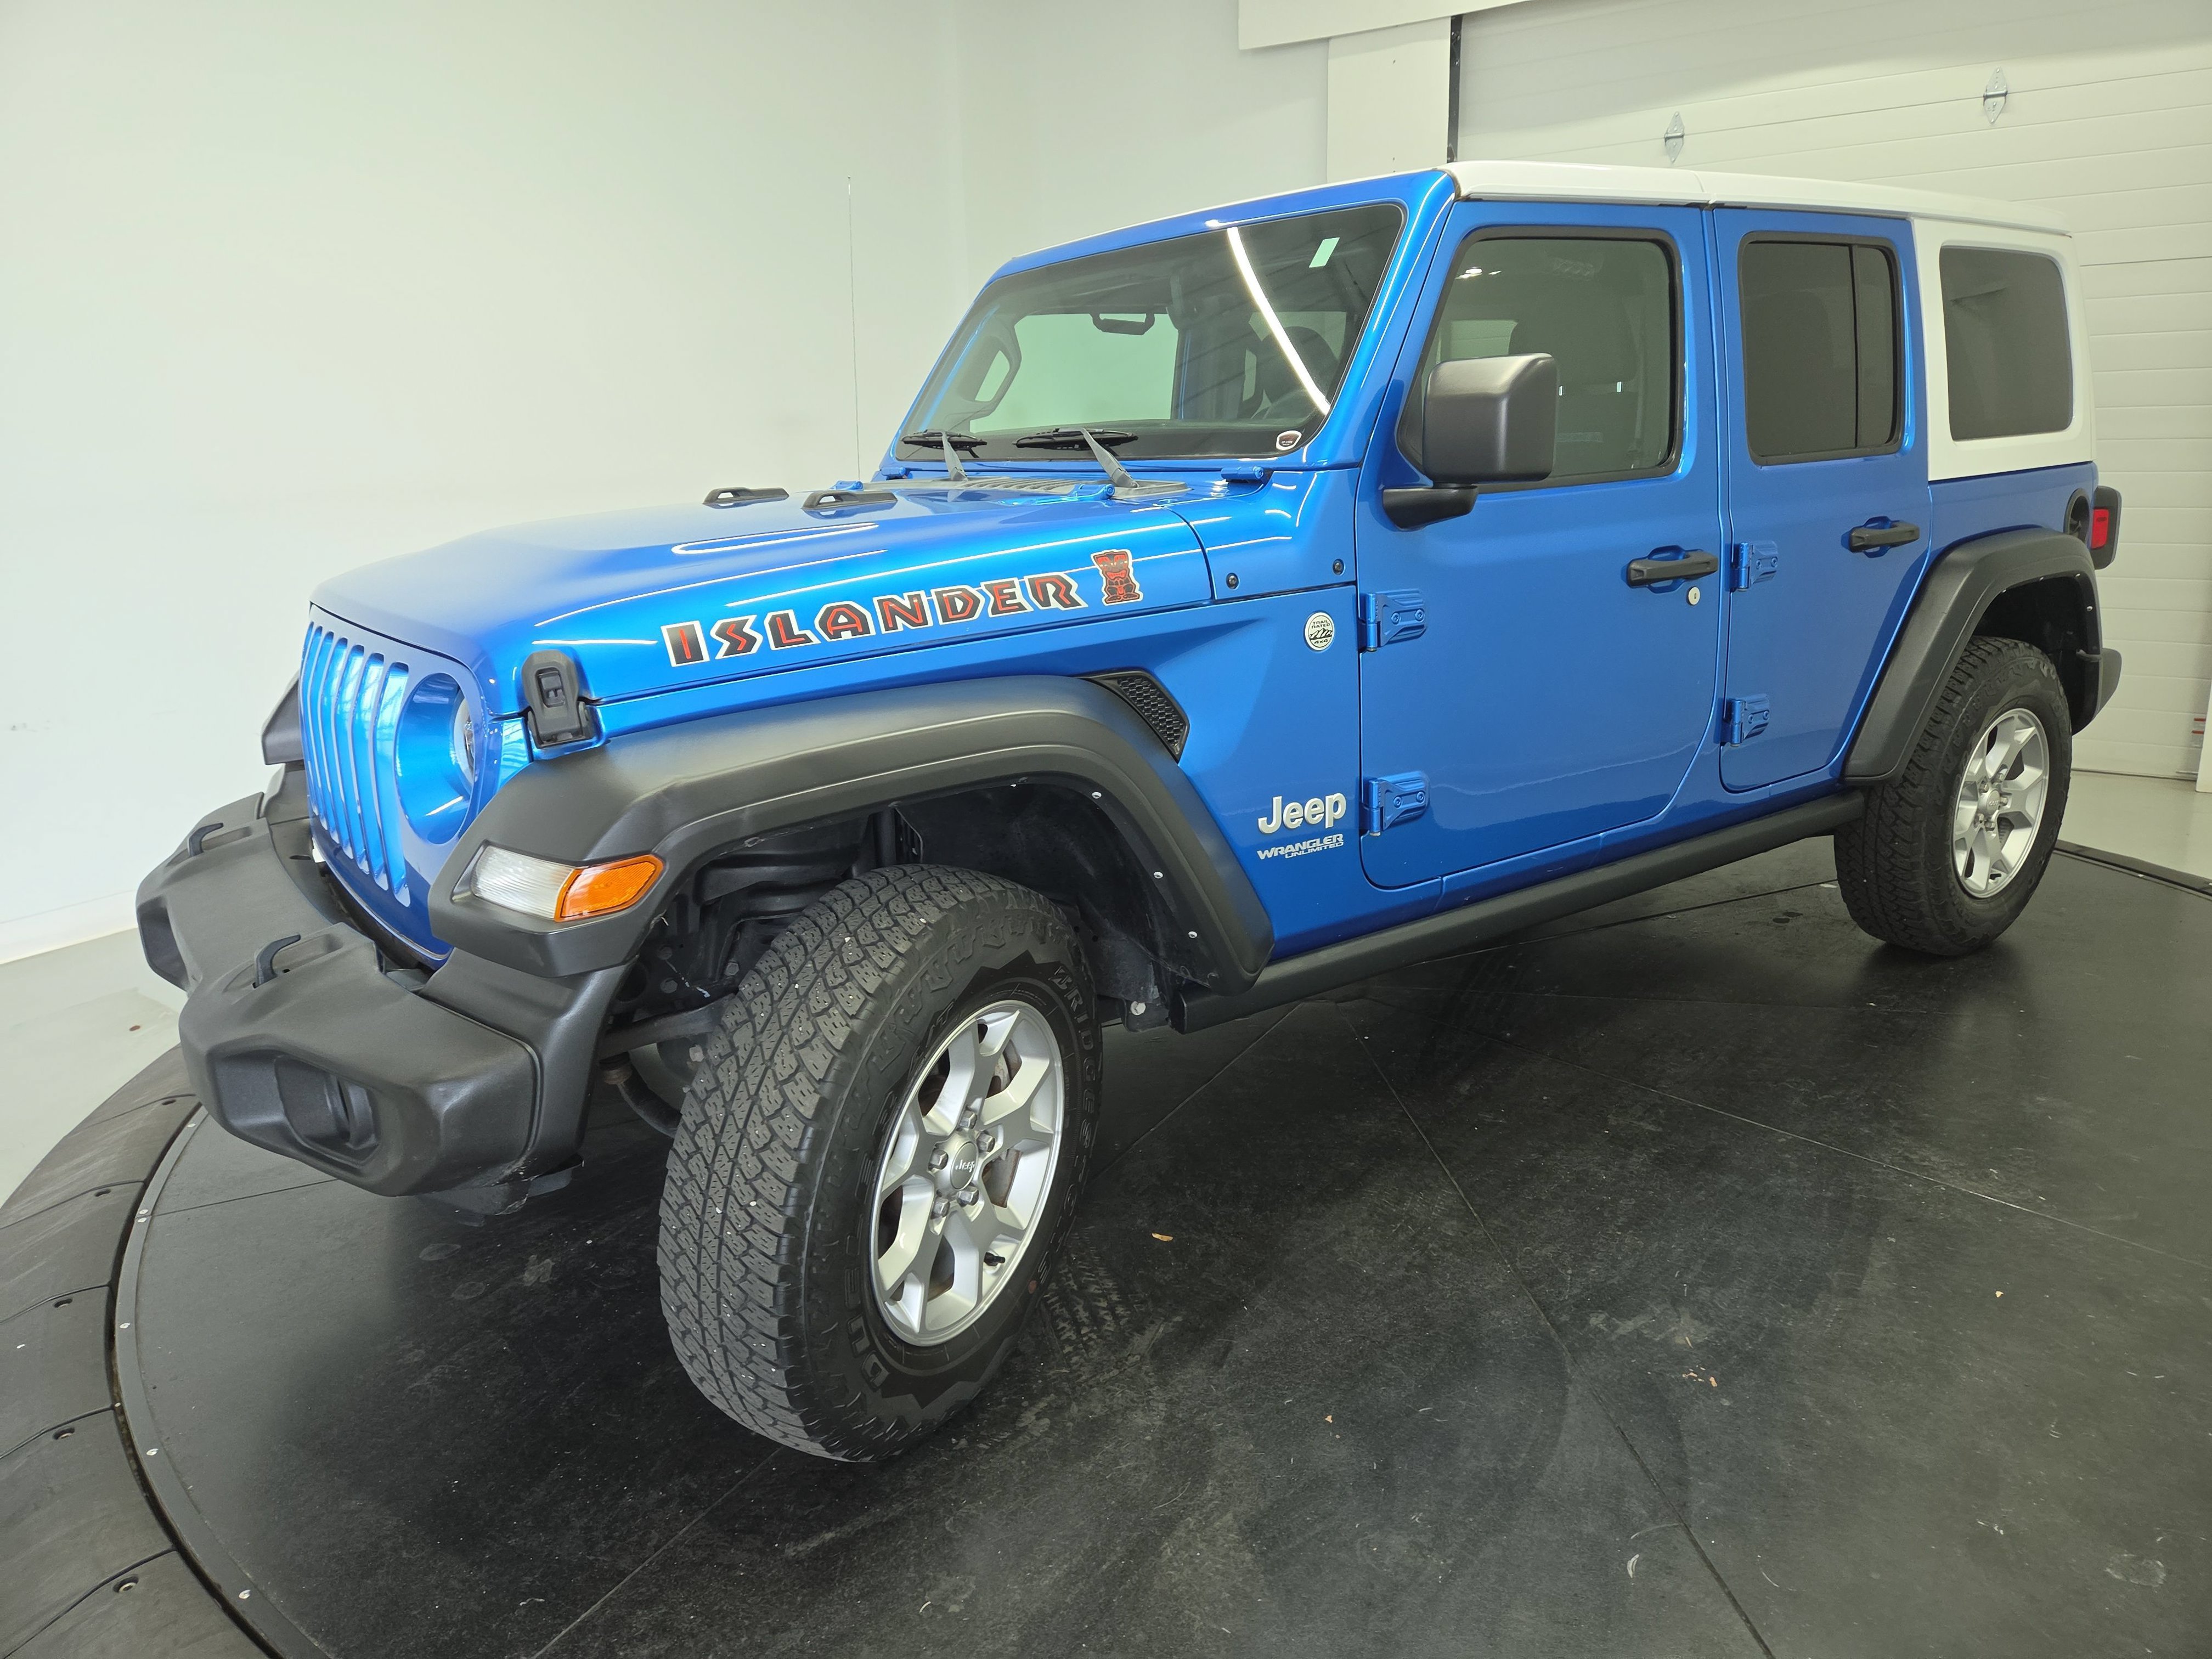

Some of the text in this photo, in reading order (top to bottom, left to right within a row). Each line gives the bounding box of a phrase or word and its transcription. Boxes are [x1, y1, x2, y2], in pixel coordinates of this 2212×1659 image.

[661, 572, 1088, 667] ISLANDER
[1258, 793, 1346, 833] Jeep
[1257, 833, 1344, 860] WRANGLER
[1285, 842, 1344, 859] UNLIMITED
[955, 1159, 975, 1173] Jeep
